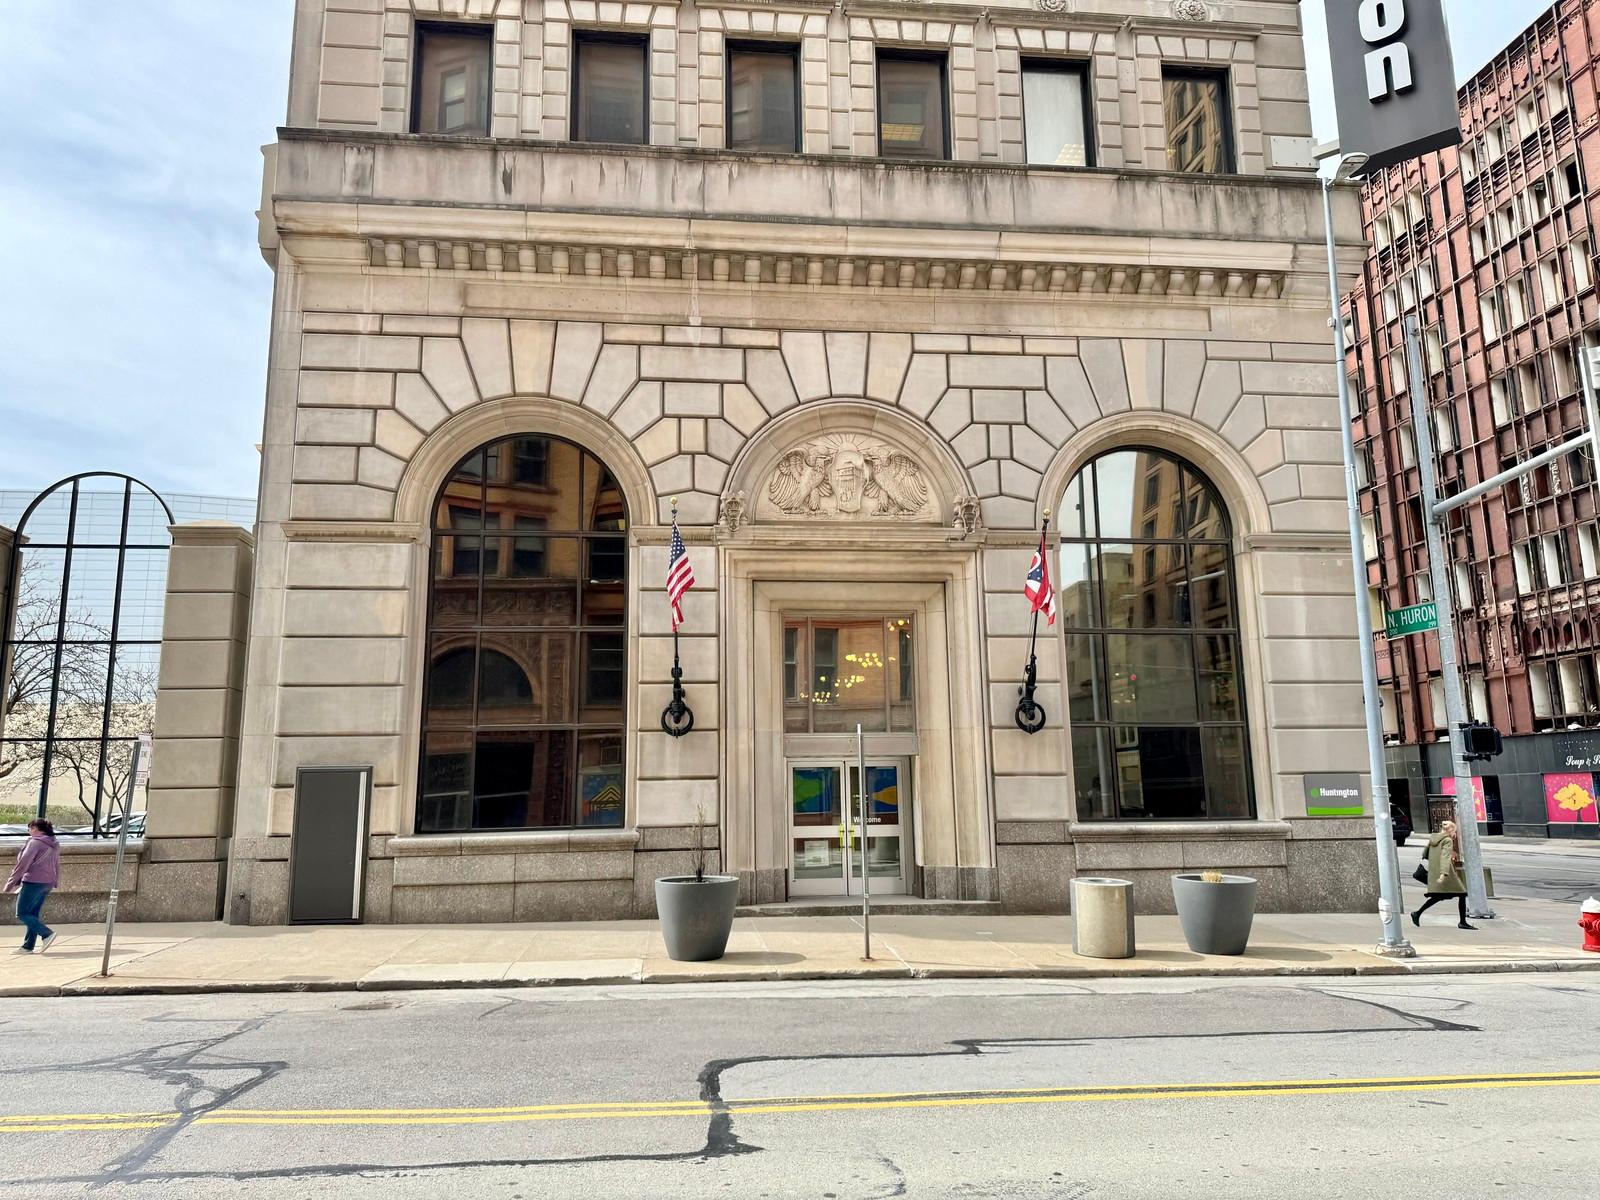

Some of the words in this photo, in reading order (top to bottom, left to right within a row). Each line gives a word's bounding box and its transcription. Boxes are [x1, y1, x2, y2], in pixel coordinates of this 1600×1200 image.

[1387, 613, 1399, 628] N.
[1400, 604, 1436, 626] HURON
[1565, 755, 1585, 769] Soup
[1585, 757, 1592, 767] &
[1319, 787, 1359, 799] Huntington
